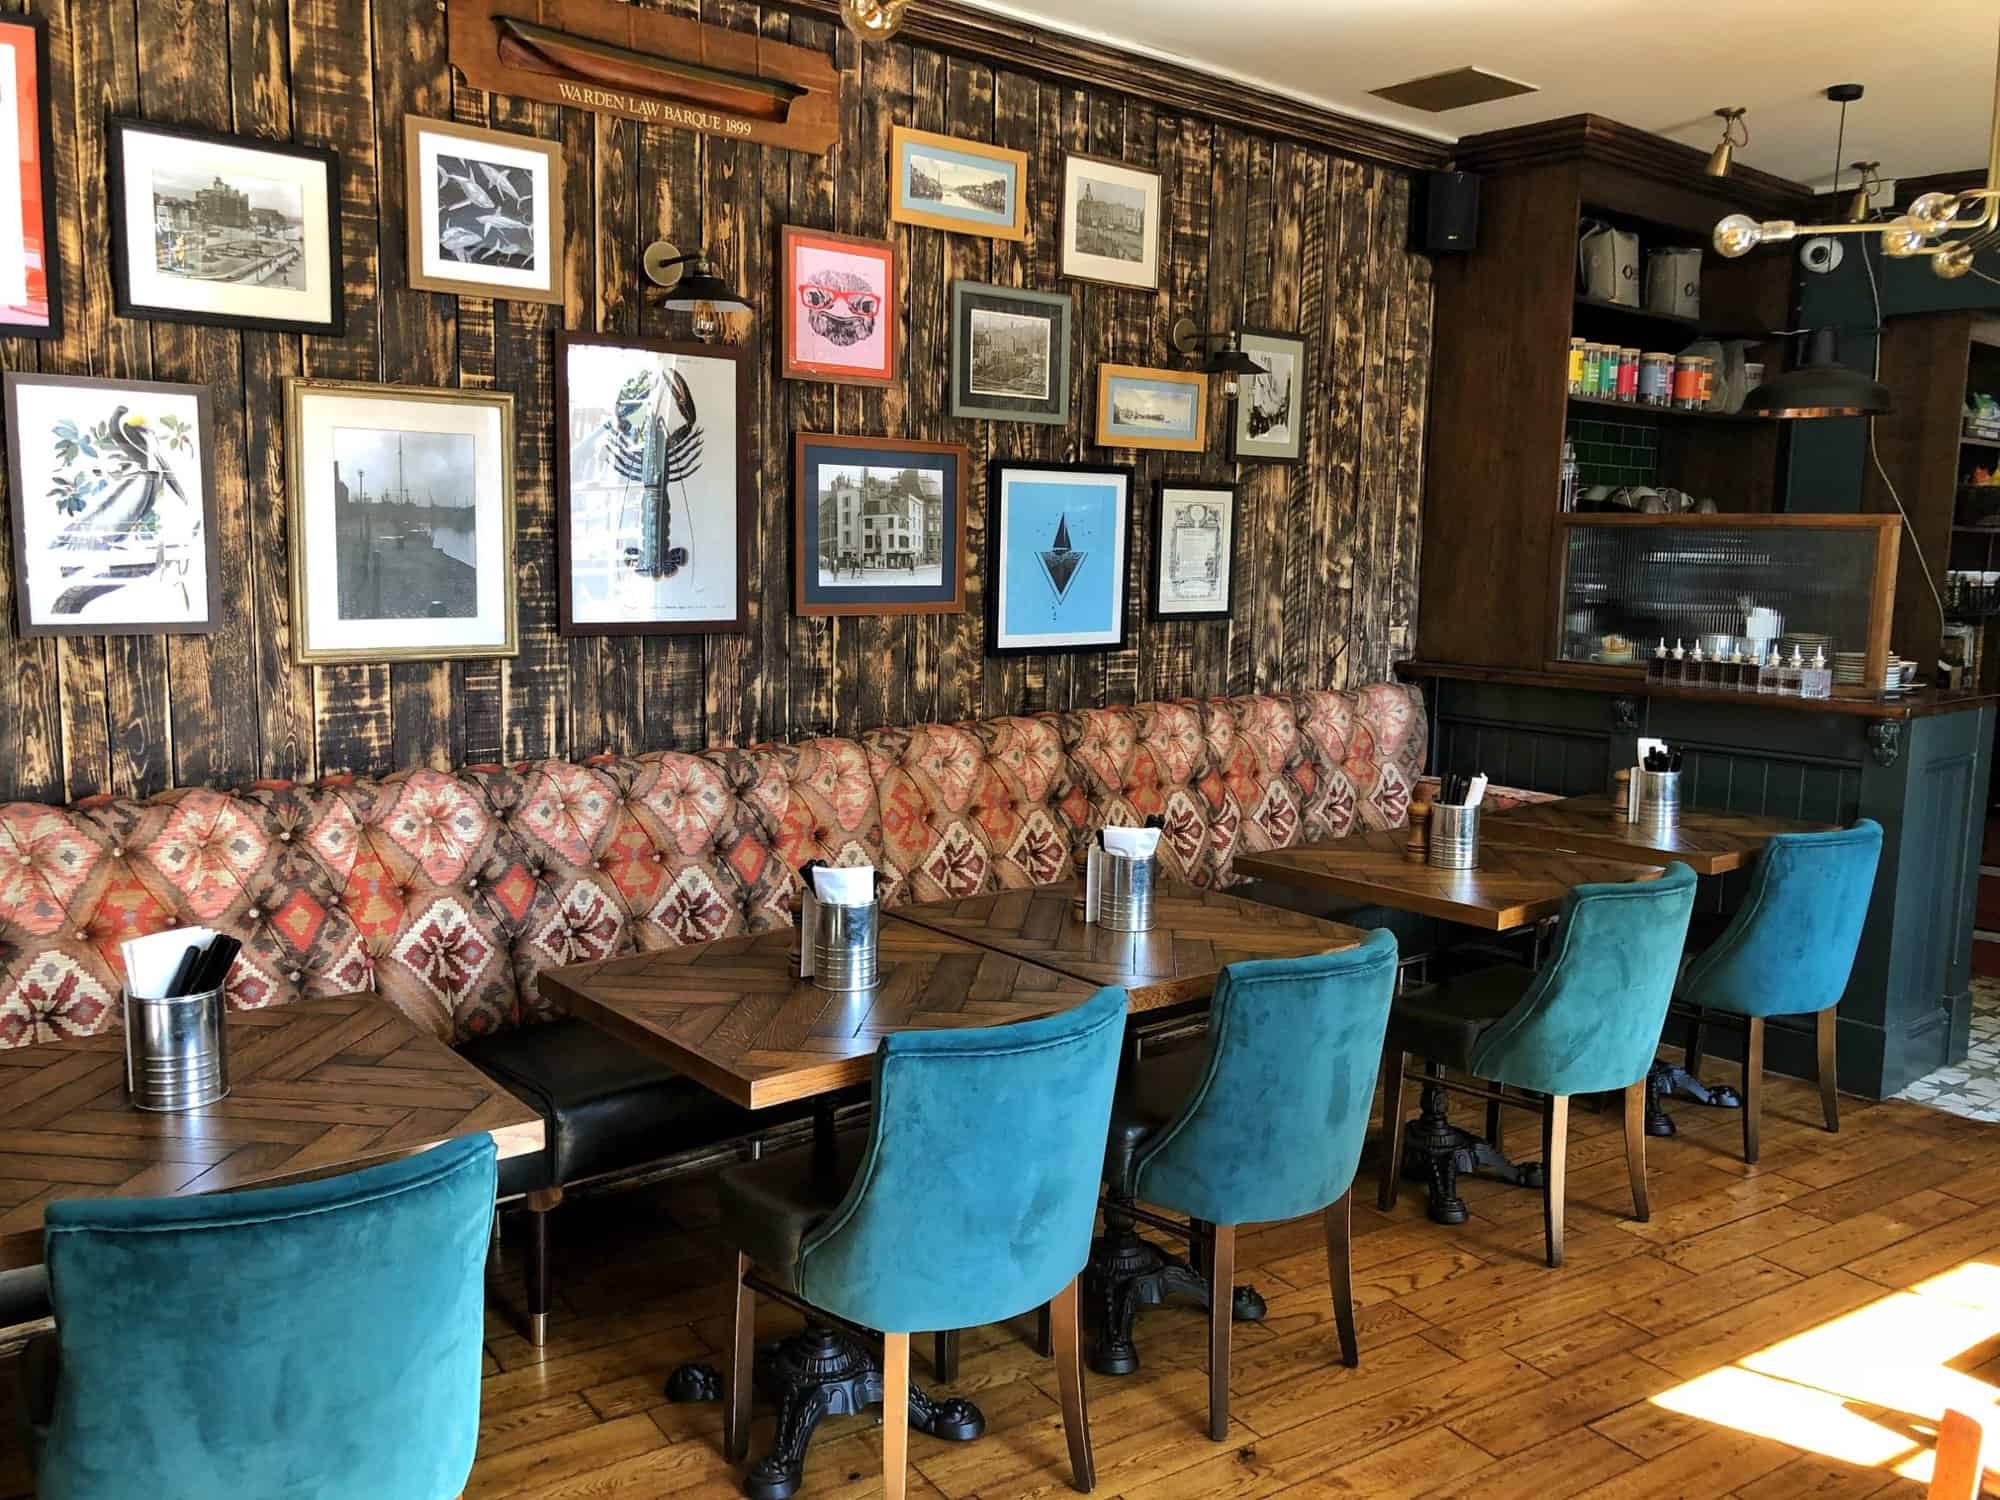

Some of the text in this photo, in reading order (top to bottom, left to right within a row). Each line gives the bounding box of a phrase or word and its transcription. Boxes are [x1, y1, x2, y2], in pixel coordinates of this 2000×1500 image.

[559, 83, 753, 136] WARDEN LAW BARQUE 1899
